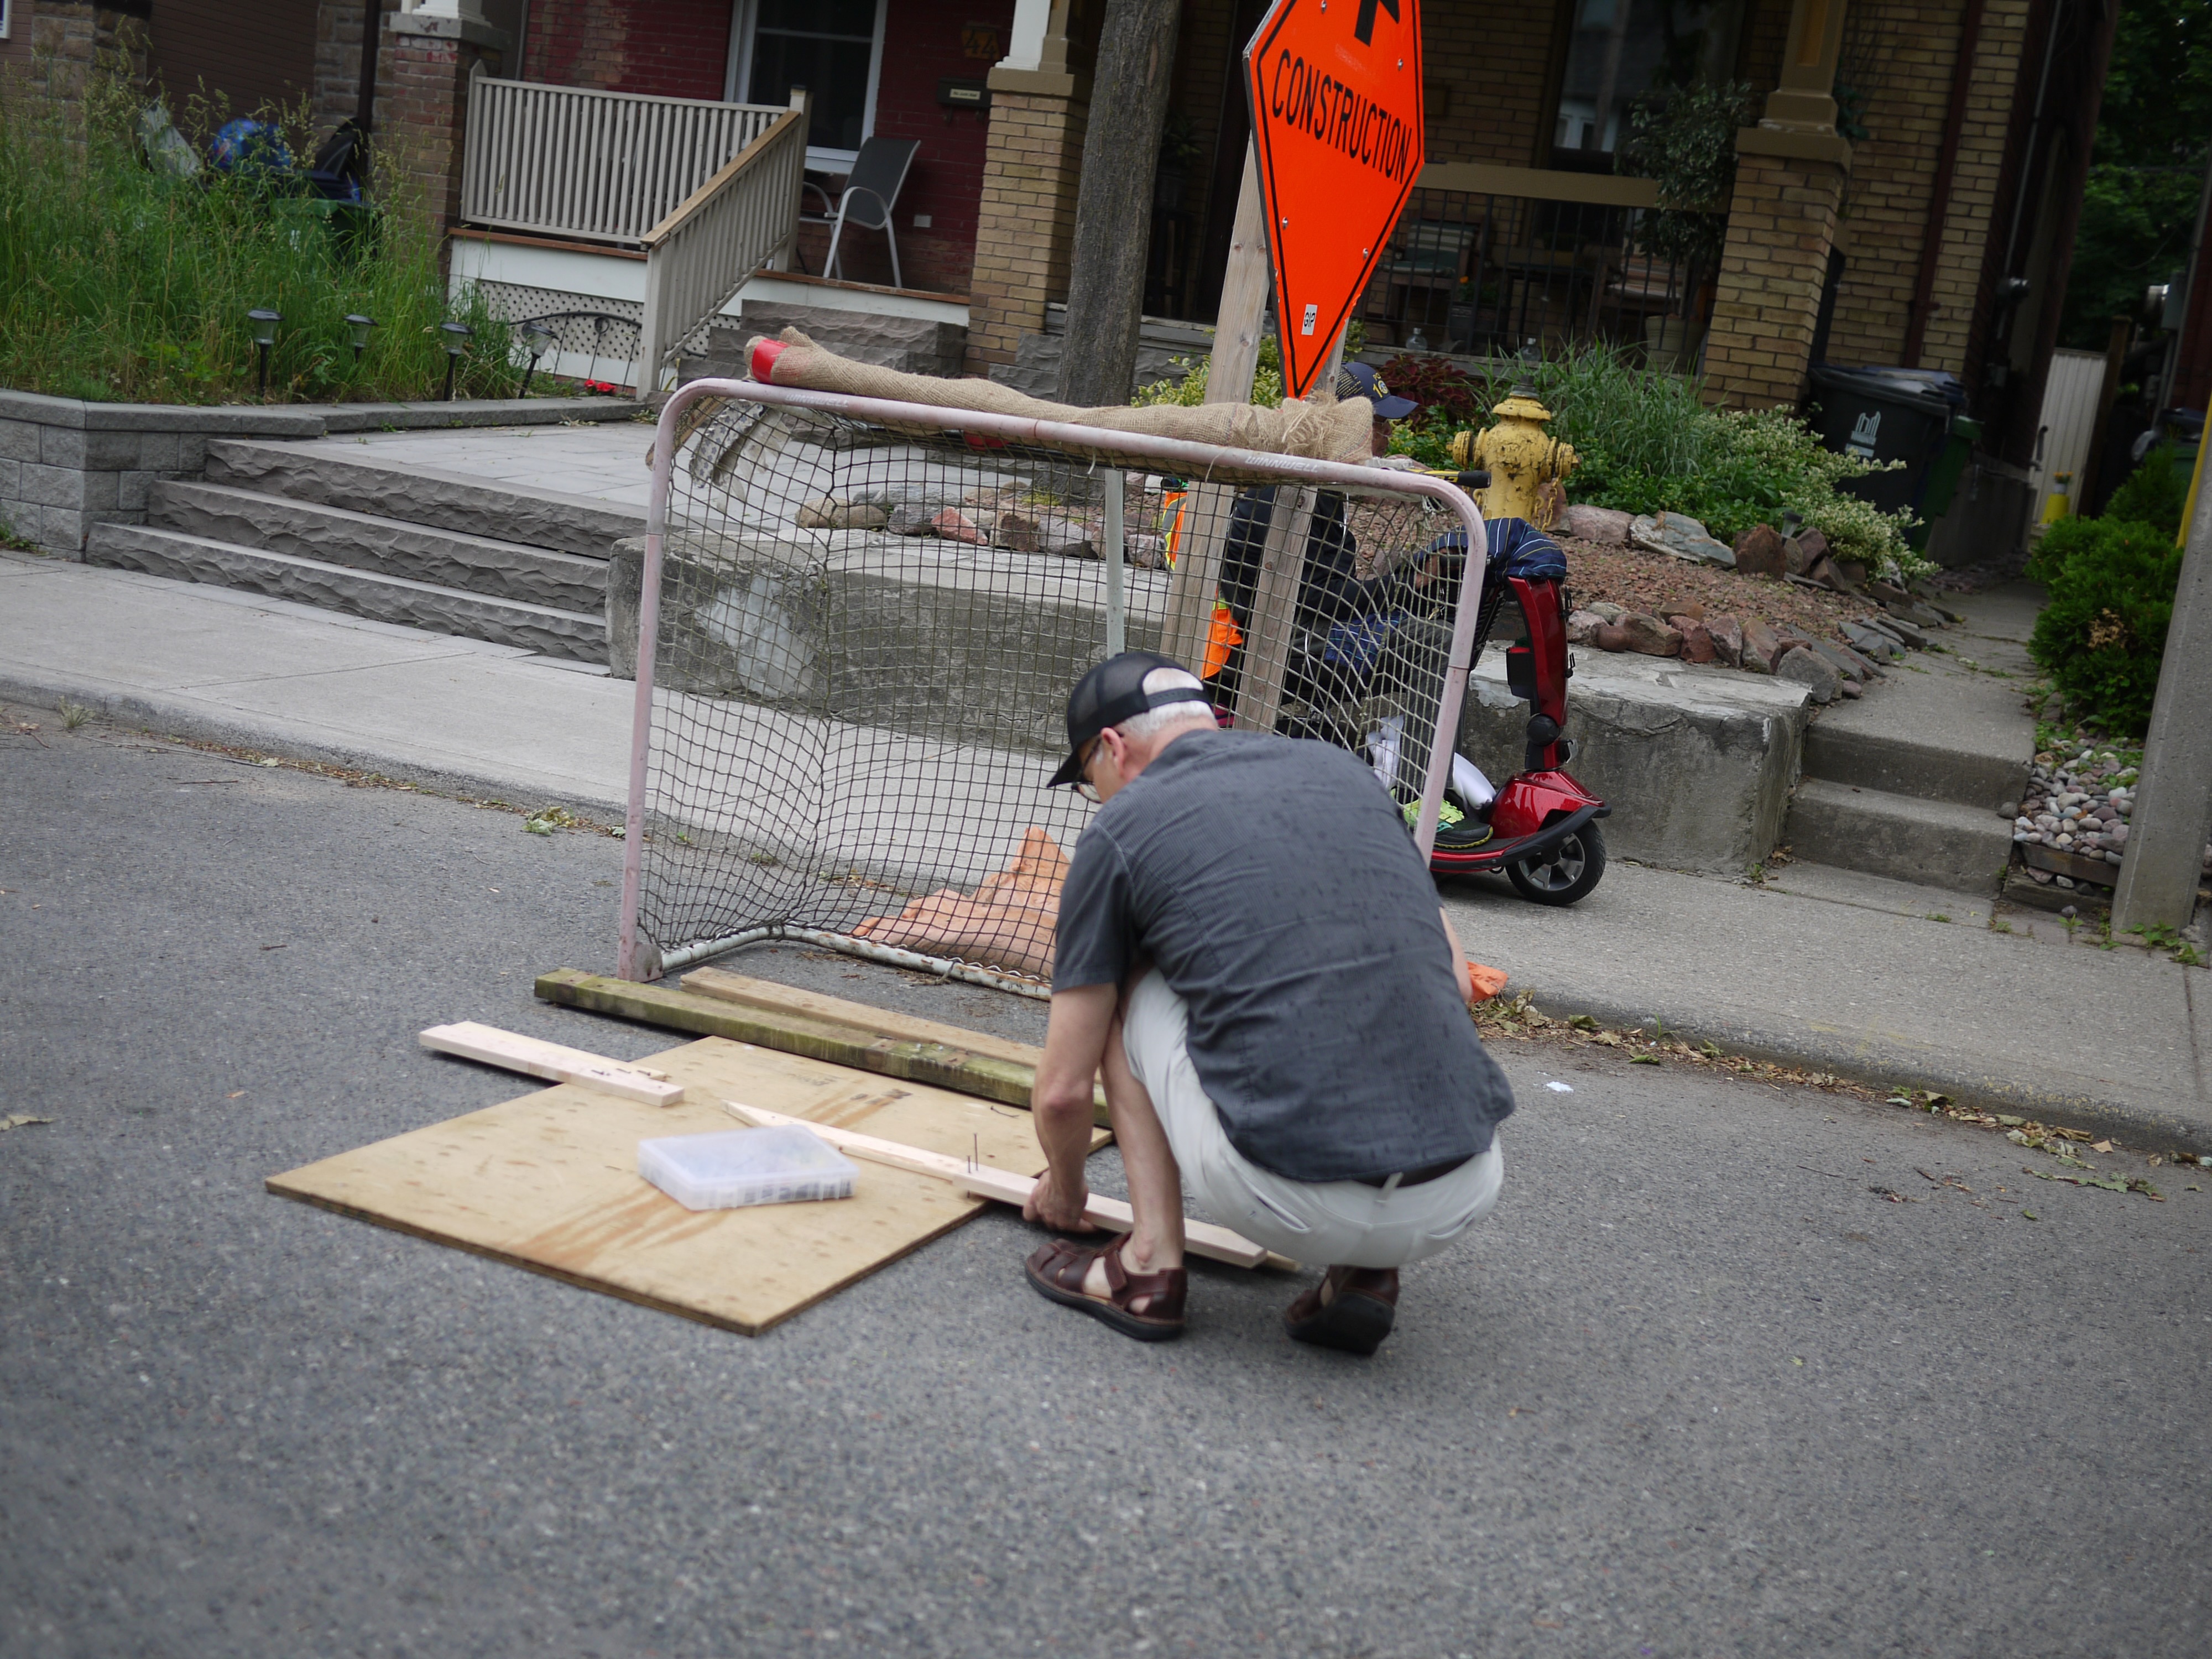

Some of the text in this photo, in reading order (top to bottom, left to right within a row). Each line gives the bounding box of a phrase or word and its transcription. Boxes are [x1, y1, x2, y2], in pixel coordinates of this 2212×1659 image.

[1272, 48, 1412, 184] CONSTRUCTION
[785, 394, 848, 407] WINNWELL
[1245, 456, 1318, 472] WINNWELL
